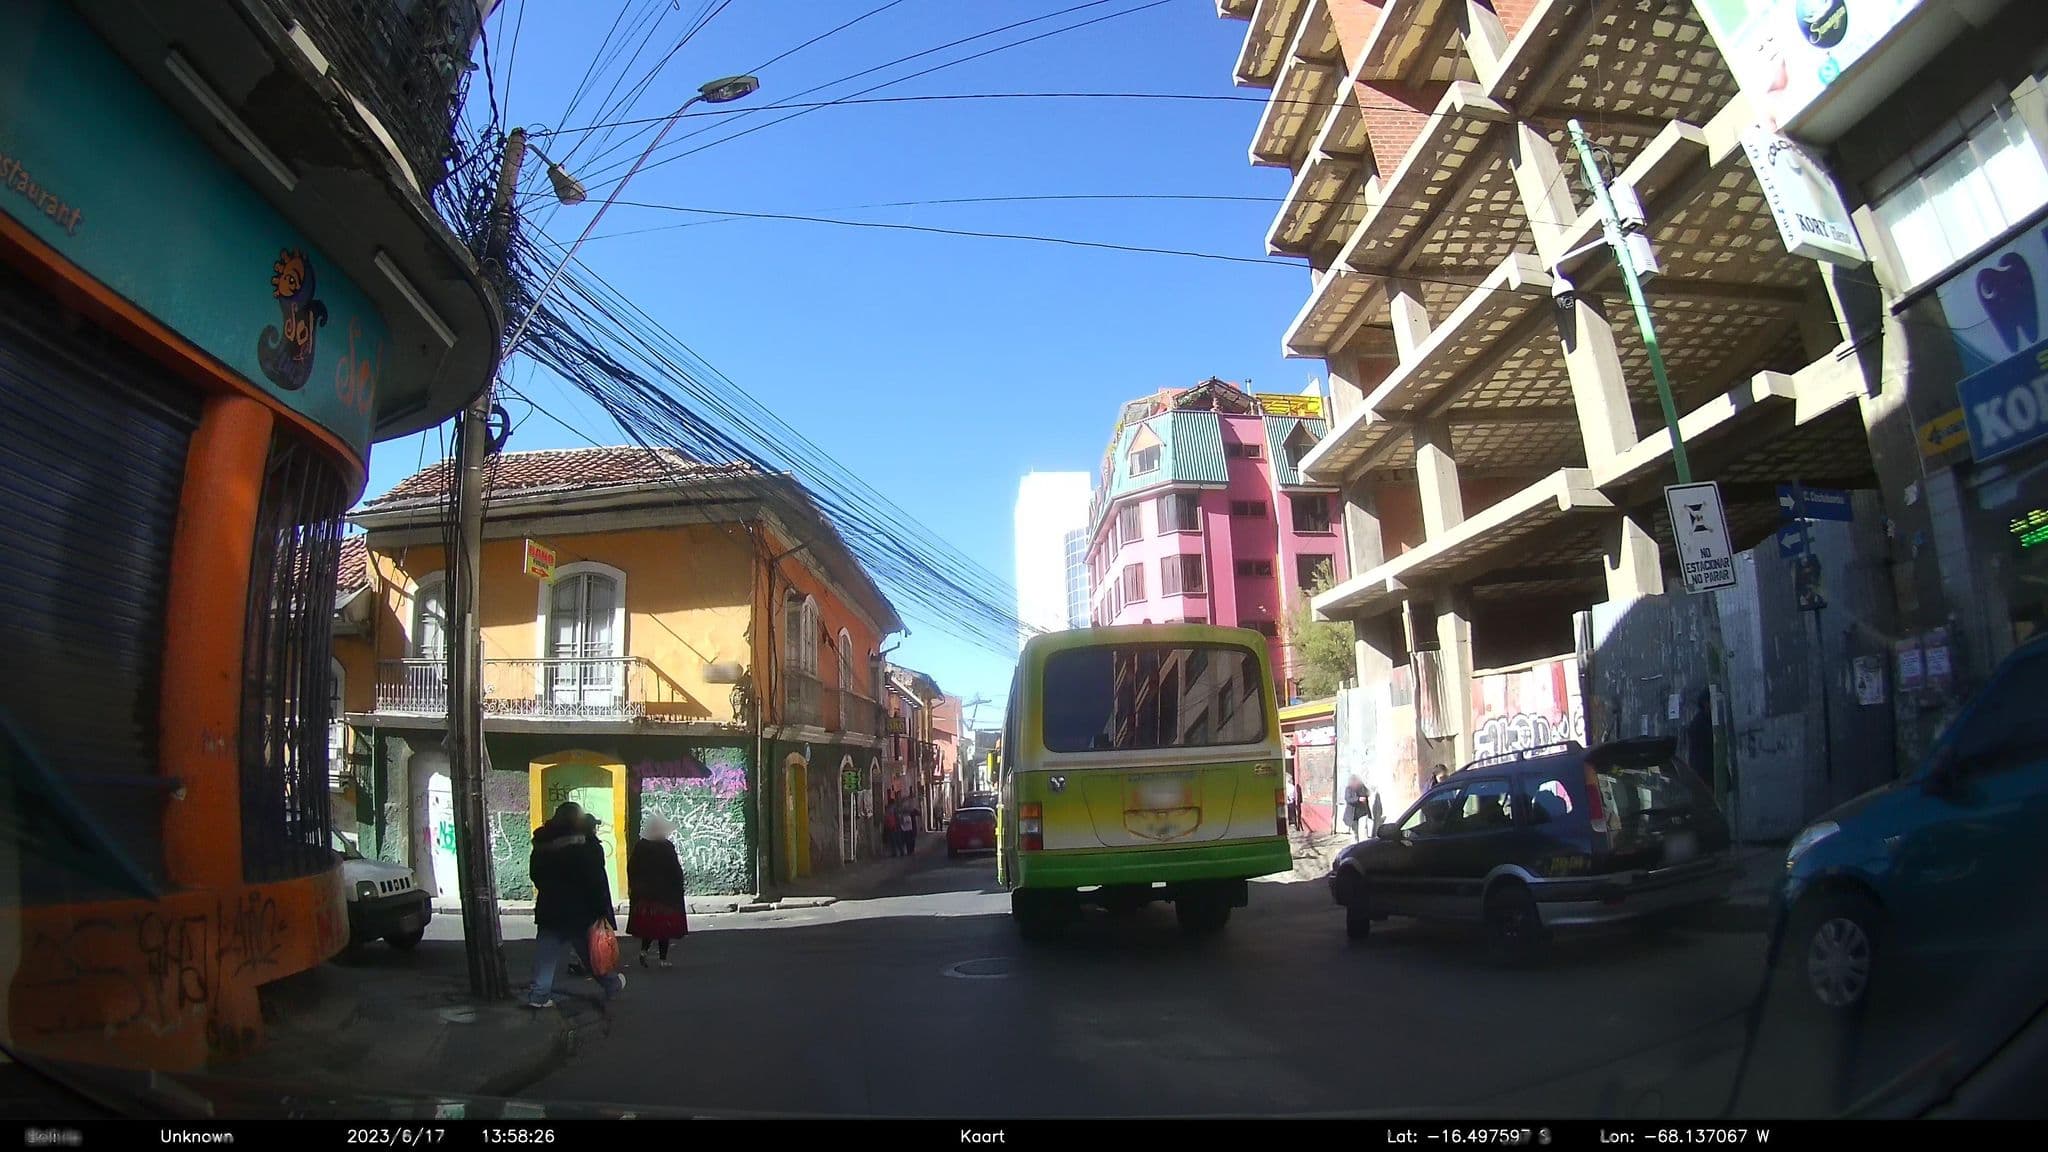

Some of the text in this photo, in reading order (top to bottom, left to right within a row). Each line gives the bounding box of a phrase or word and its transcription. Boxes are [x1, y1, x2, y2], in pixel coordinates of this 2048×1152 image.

[1795, 212, 1830, 238] KORY
[1699, 547, 1712, 559] NO
[1686, 557, 1730, 574] ESTACIONAR
[1691, 569, 1730, 585] NO PARAR
